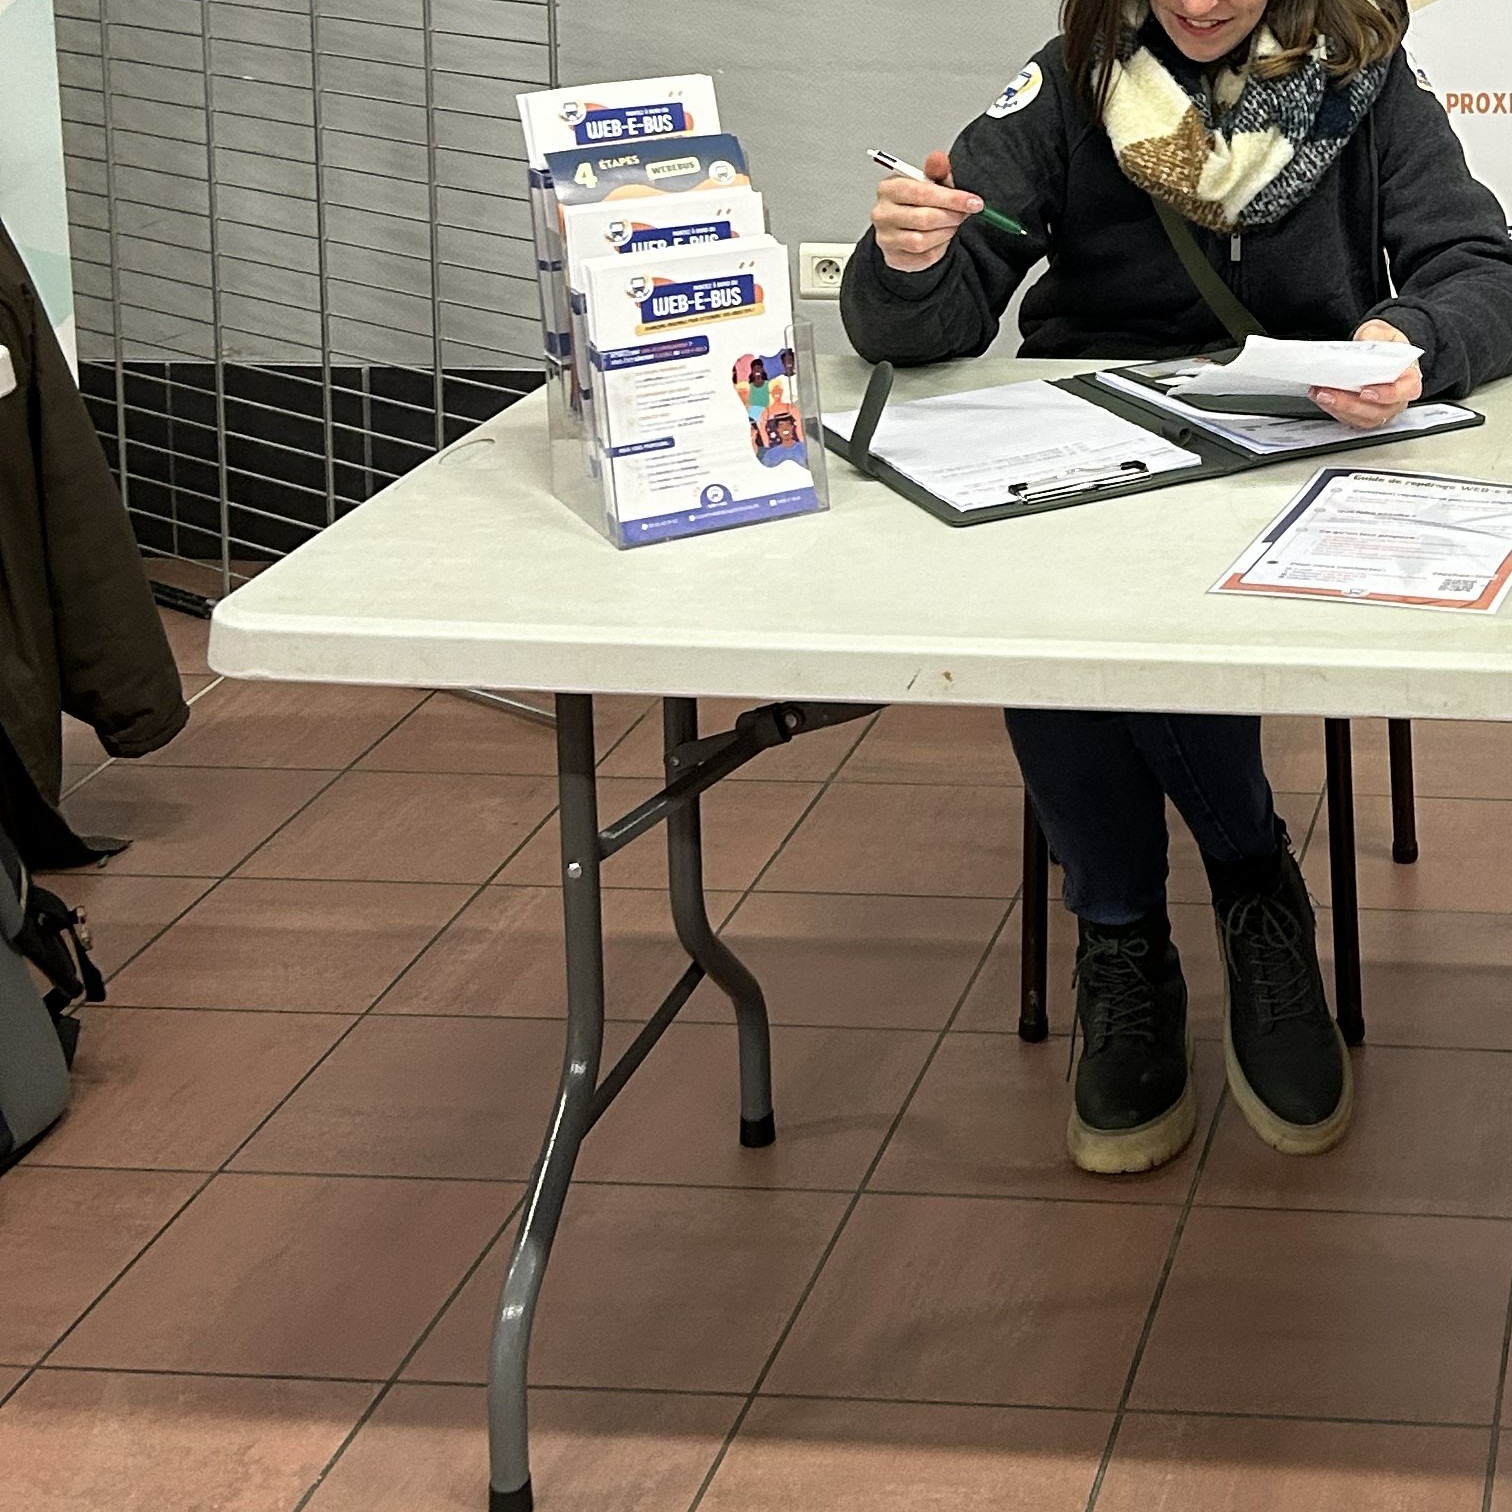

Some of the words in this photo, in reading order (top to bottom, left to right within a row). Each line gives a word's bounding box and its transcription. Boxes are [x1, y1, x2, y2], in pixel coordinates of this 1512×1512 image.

[586, 114, 674, 139] WEB-E-BUS
[574, 162, 598, 188] 4
[652, 287, 743, 317] WEB-E-BUS
